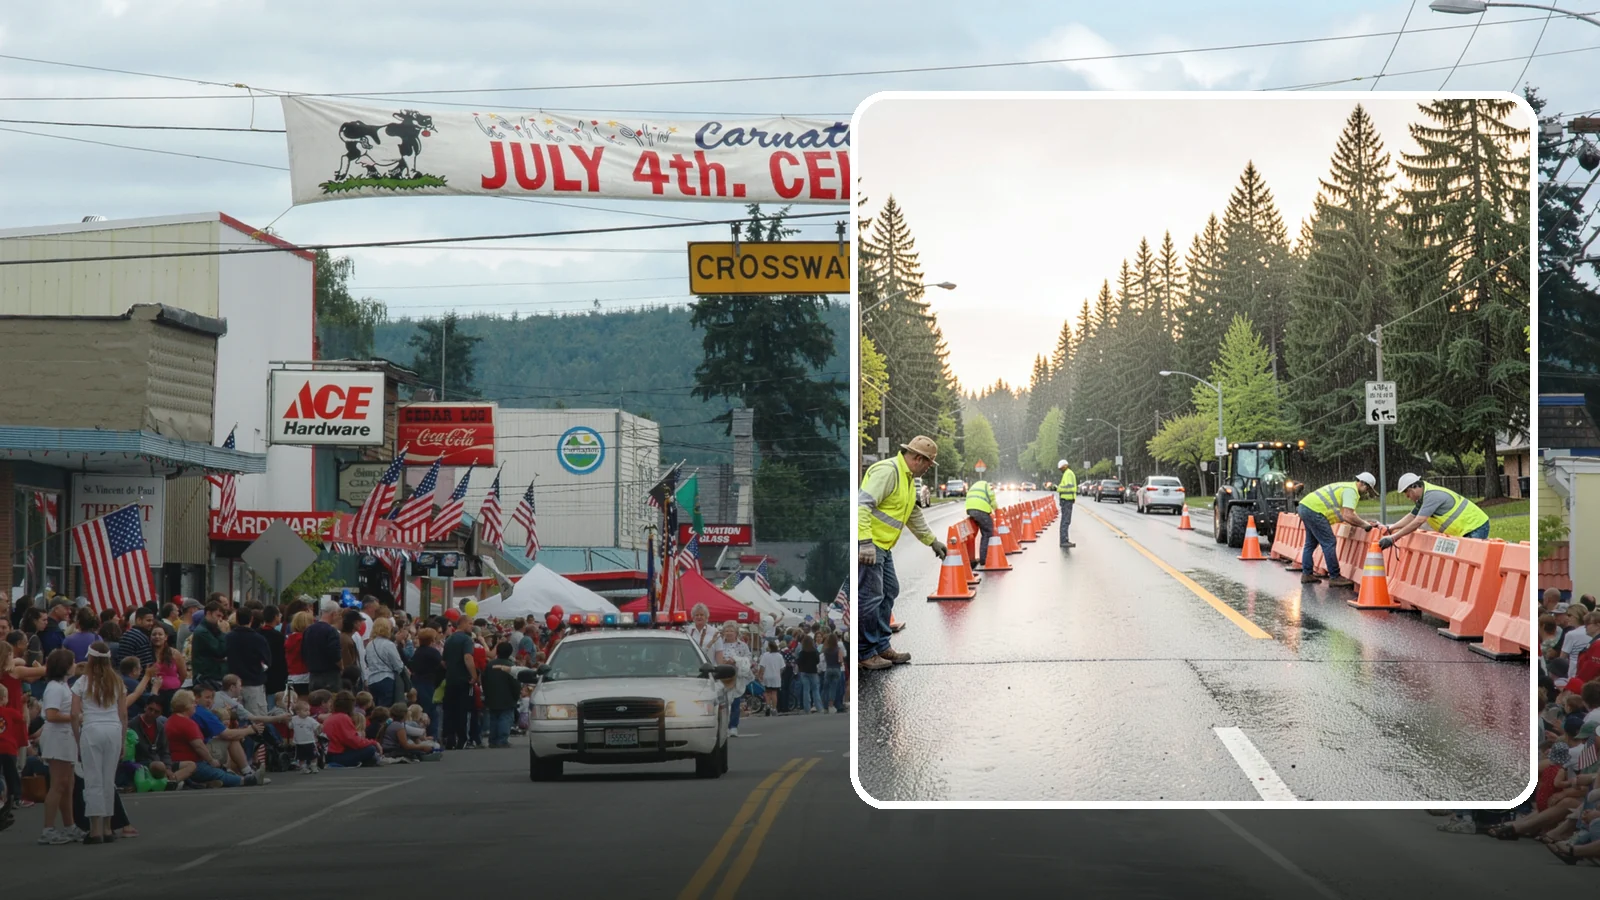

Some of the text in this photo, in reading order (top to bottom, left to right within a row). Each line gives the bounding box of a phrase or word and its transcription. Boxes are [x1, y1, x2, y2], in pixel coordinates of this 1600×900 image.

[481, 140, 605, 192] JULY
[632, 150, 746, 198] 4th.
[697, 254, 850, 280] CROSSWA
[283, 380, 374, 420] ACE
[405, 409, 485, 421] CEDAR LOG
[283, 421, 371, 437] Hardware
[416, 428, 477, 447] Coca-Cola
[353, 467, 384, 480] Simpl
[95, 485, 124, 494] Vincent
[126, 486, 135, 494] de
[137, 486, 155, 495] Paul
[699, 535, 730, 543] GLASS
